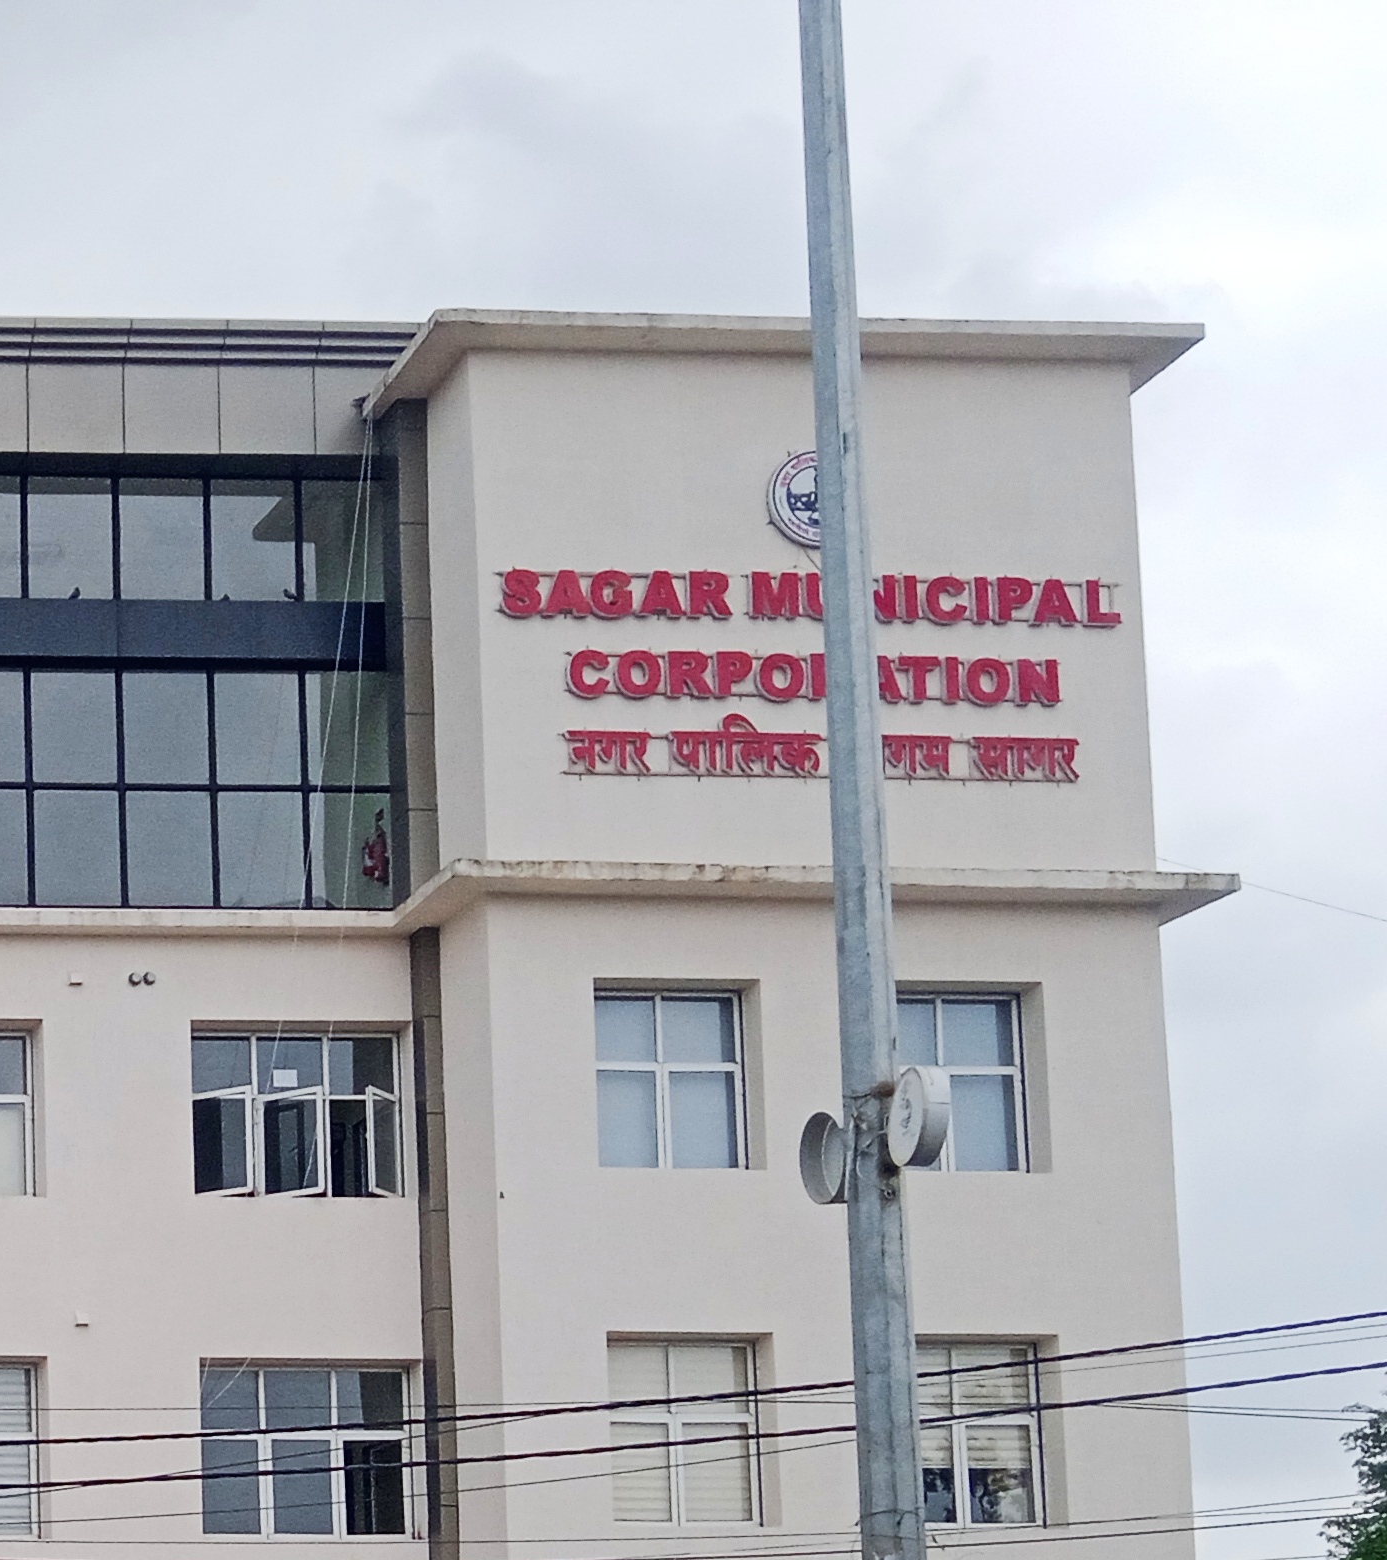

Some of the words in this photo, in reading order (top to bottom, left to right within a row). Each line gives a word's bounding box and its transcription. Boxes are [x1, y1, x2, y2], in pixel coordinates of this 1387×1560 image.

[501, 568, 733, 618] SAGAR
[566, 729, 652, 775] नगर
[971, 735, 1080, 781] सागर
